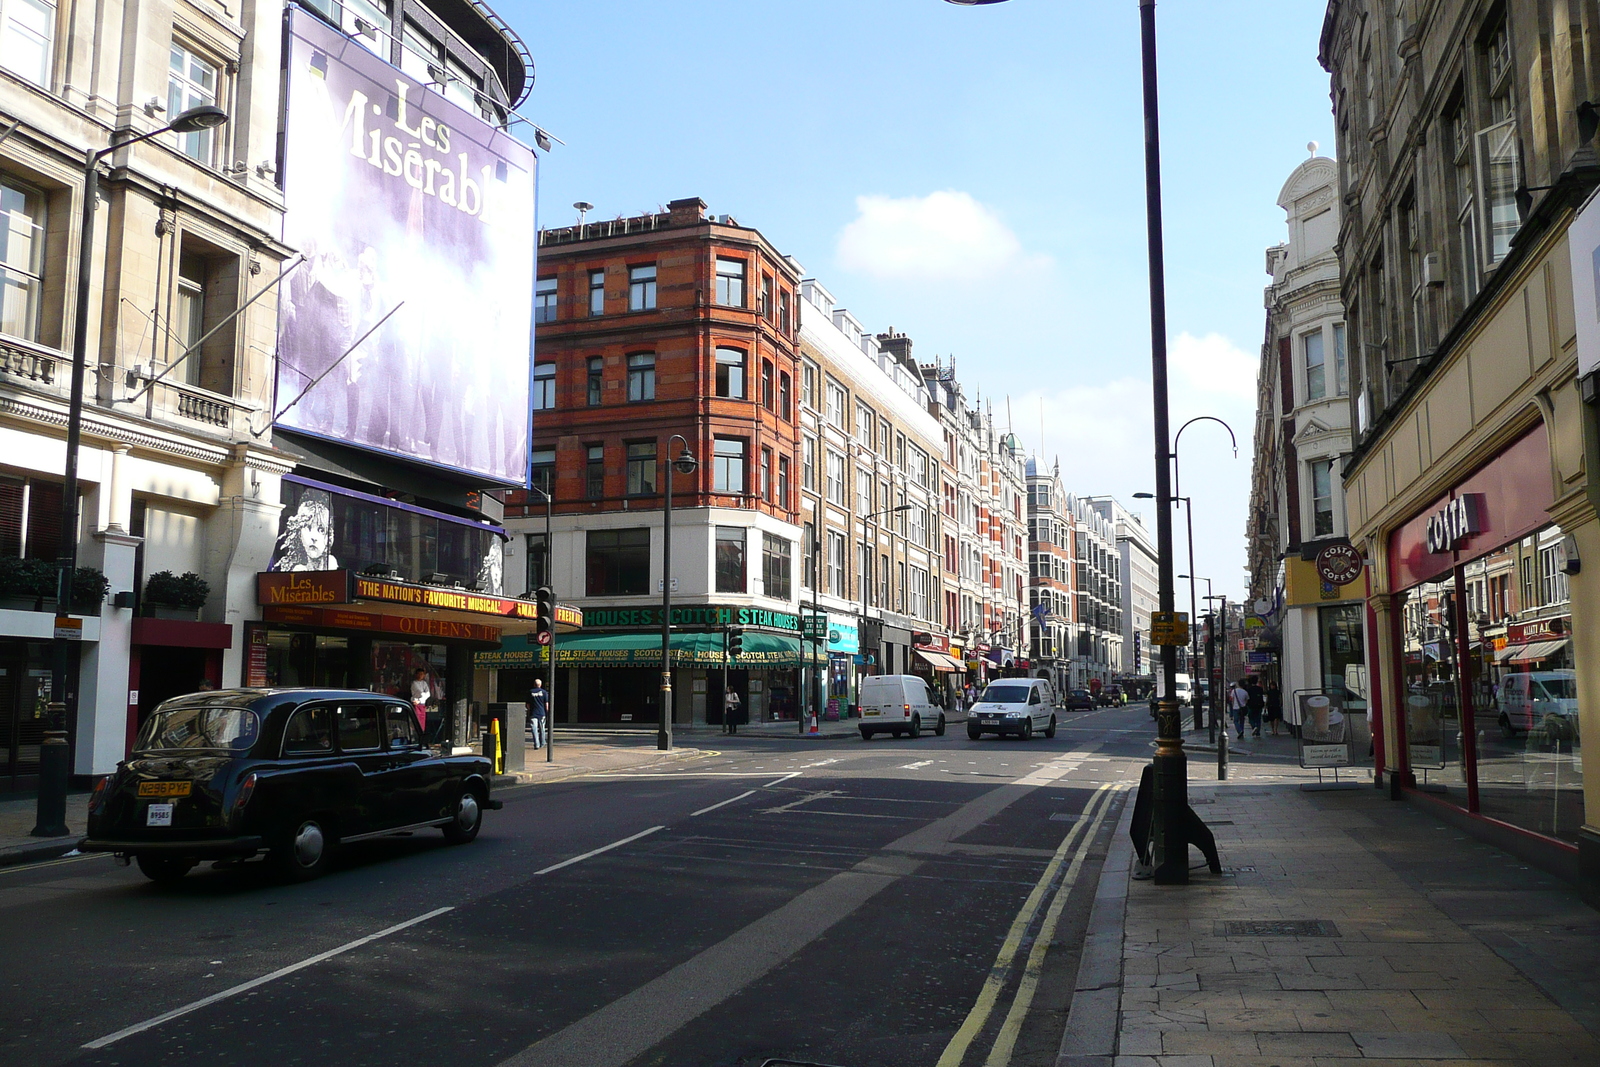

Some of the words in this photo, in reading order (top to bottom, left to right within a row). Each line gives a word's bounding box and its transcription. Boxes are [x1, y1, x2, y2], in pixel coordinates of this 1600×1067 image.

[394, 78, 451, 154] Les
[1426, 494, 1469, 555] COSTA
[1324, 546, 1353, 559] COSTA
[289, 573, 312, 590] Les
[1323, 567, 1357, 581] COFFEE
[270, 584, 335, 603] Misérables
[382, 584, 421, 603] NATION'S
[423, 590, 466, 609] FAVOURITE
[400, 617, 472, 638] QUEEN'S
[584, 609, 653, 626] HOUSES
[738, 608, 774, 627] STEAK
[773, 611, 799, 631] HOUSES
[599, 649, 629, 657] HOUSES
[140, 783, 166, 794] N296
[168, 782, 190, 793] PYF
